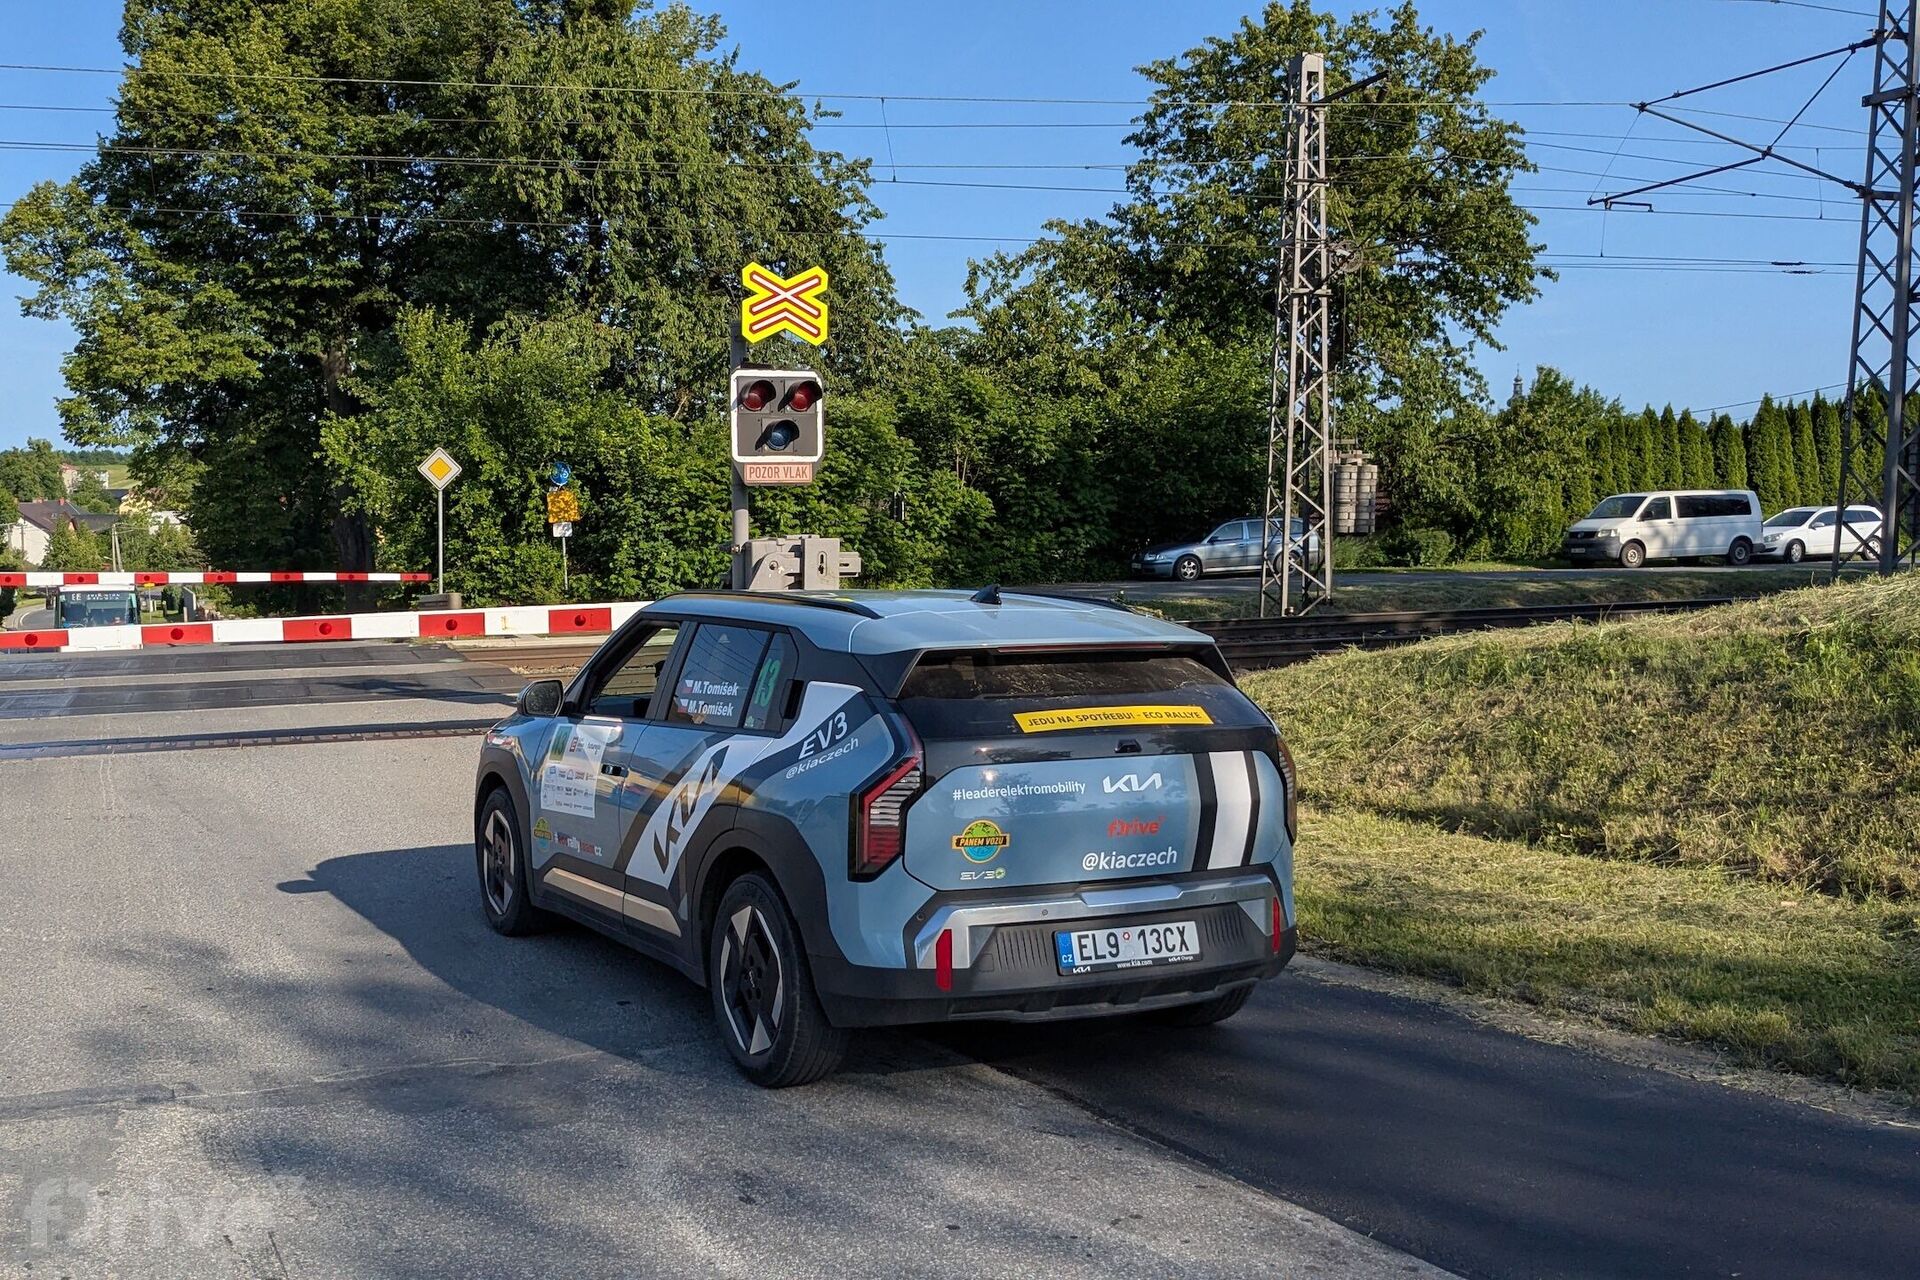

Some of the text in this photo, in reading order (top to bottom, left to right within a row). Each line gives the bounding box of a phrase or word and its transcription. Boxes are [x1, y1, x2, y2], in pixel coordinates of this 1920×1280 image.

[749, 466, 808, 479] POZOR VLAK
[1027, 717, 1055, 727] JEDU
[1059, 715, 1074, 724] NA
[1078, 712, 1134, 722] SPOTŘEBU!
[1144, 711, 1163, 719] ECO
[1166, 711, 1202, 719] RALLYE
[798, 711, 848, 760] EV3
[785, 737, 859, 779] @kiaczech
[952, 781, 1086, 801] #leaderelektromobility
[1102, 773, 1163, 793] KIA
[1082, 846, 1178, 871] @kiaczech
[1076, 925, 1190, 962] EL9 13CX
[1061, 954, 1073, 963] CZ
[1116, 959, 1153, 969] www.kia.com
[1072, 965, 1091, 974] KIA
